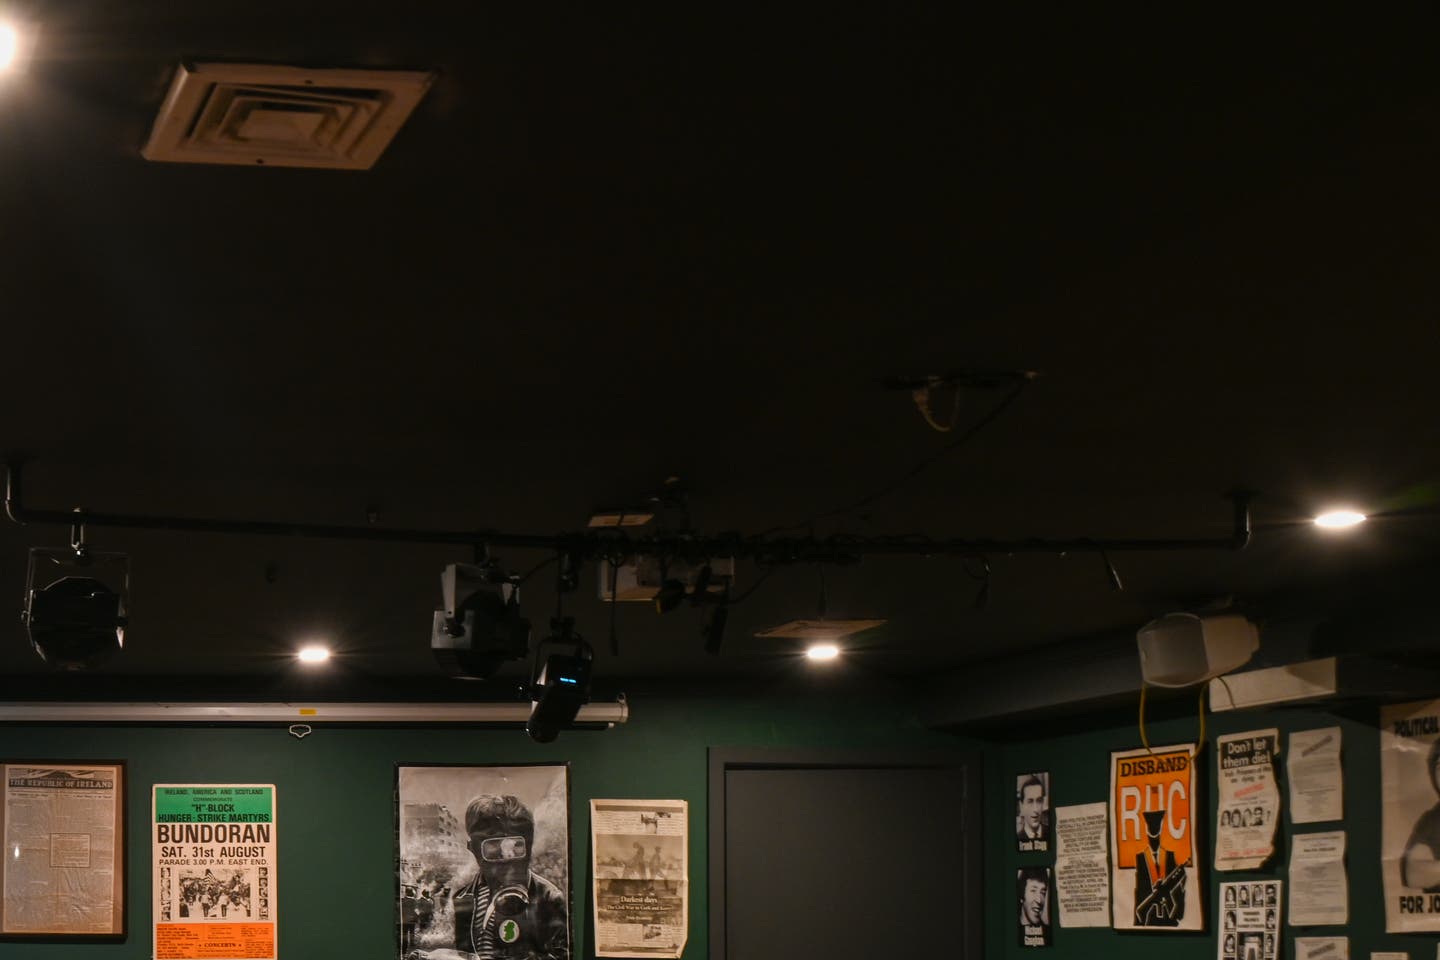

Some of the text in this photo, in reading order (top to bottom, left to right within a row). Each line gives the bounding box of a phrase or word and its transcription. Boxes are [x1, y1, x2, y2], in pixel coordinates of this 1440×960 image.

[1394, 716, 1440, 738] POLITICAL
[1228, 738, 1266, 755] Don't let
[1120, 756, 1188, 777] DISBAND
[1223, 756, 1250, 769] them
[27, 779, 64, 787] REPUBLIC
[229, 814, 269, 822] MARTYRS
[1121, 780, 1187, 841] RUC
[157, 824, 270, 843] BUNDORAN
[161, 846, 266, 858] SAT. 31st AUGUST
[644, 896, 658, 904] days
[1399, 895, 1424, 914] FOR
